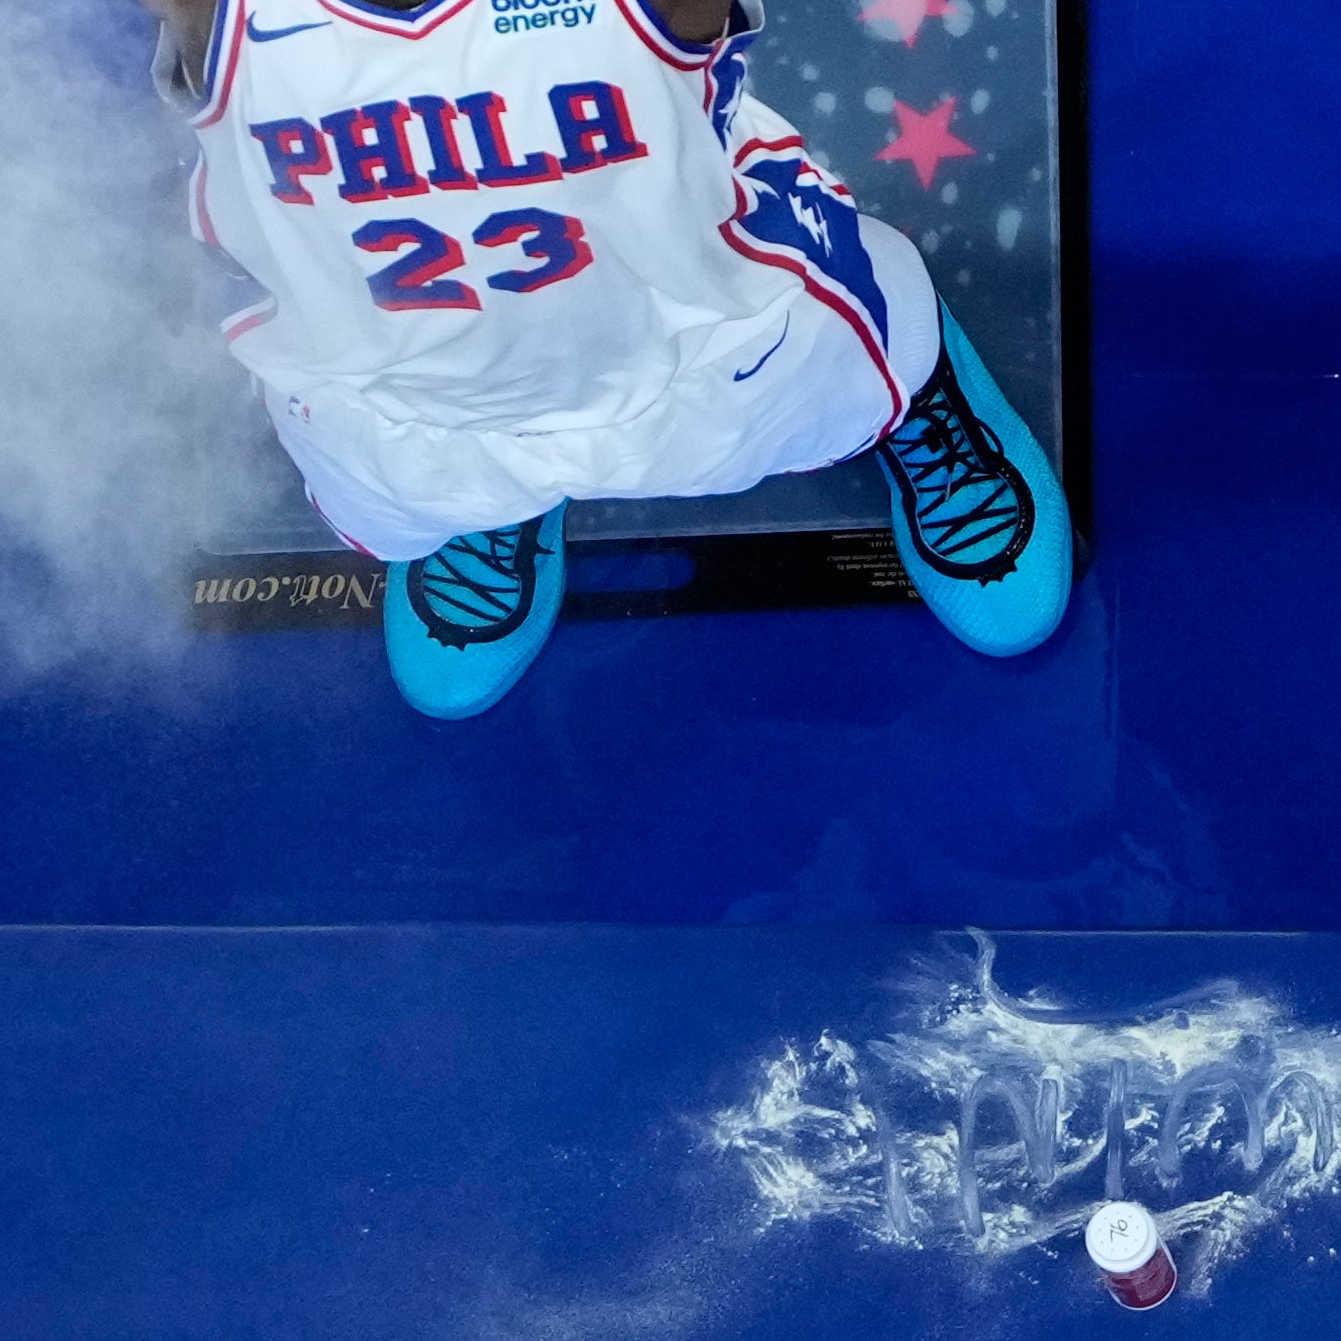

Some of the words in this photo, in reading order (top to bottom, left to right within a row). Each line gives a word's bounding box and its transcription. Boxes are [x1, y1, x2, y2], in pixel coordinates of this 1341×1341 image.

[493, 3, 597, 35] energy
[248, 80, 649, 206] PHILA
[351, 206, 595, 312] 23
